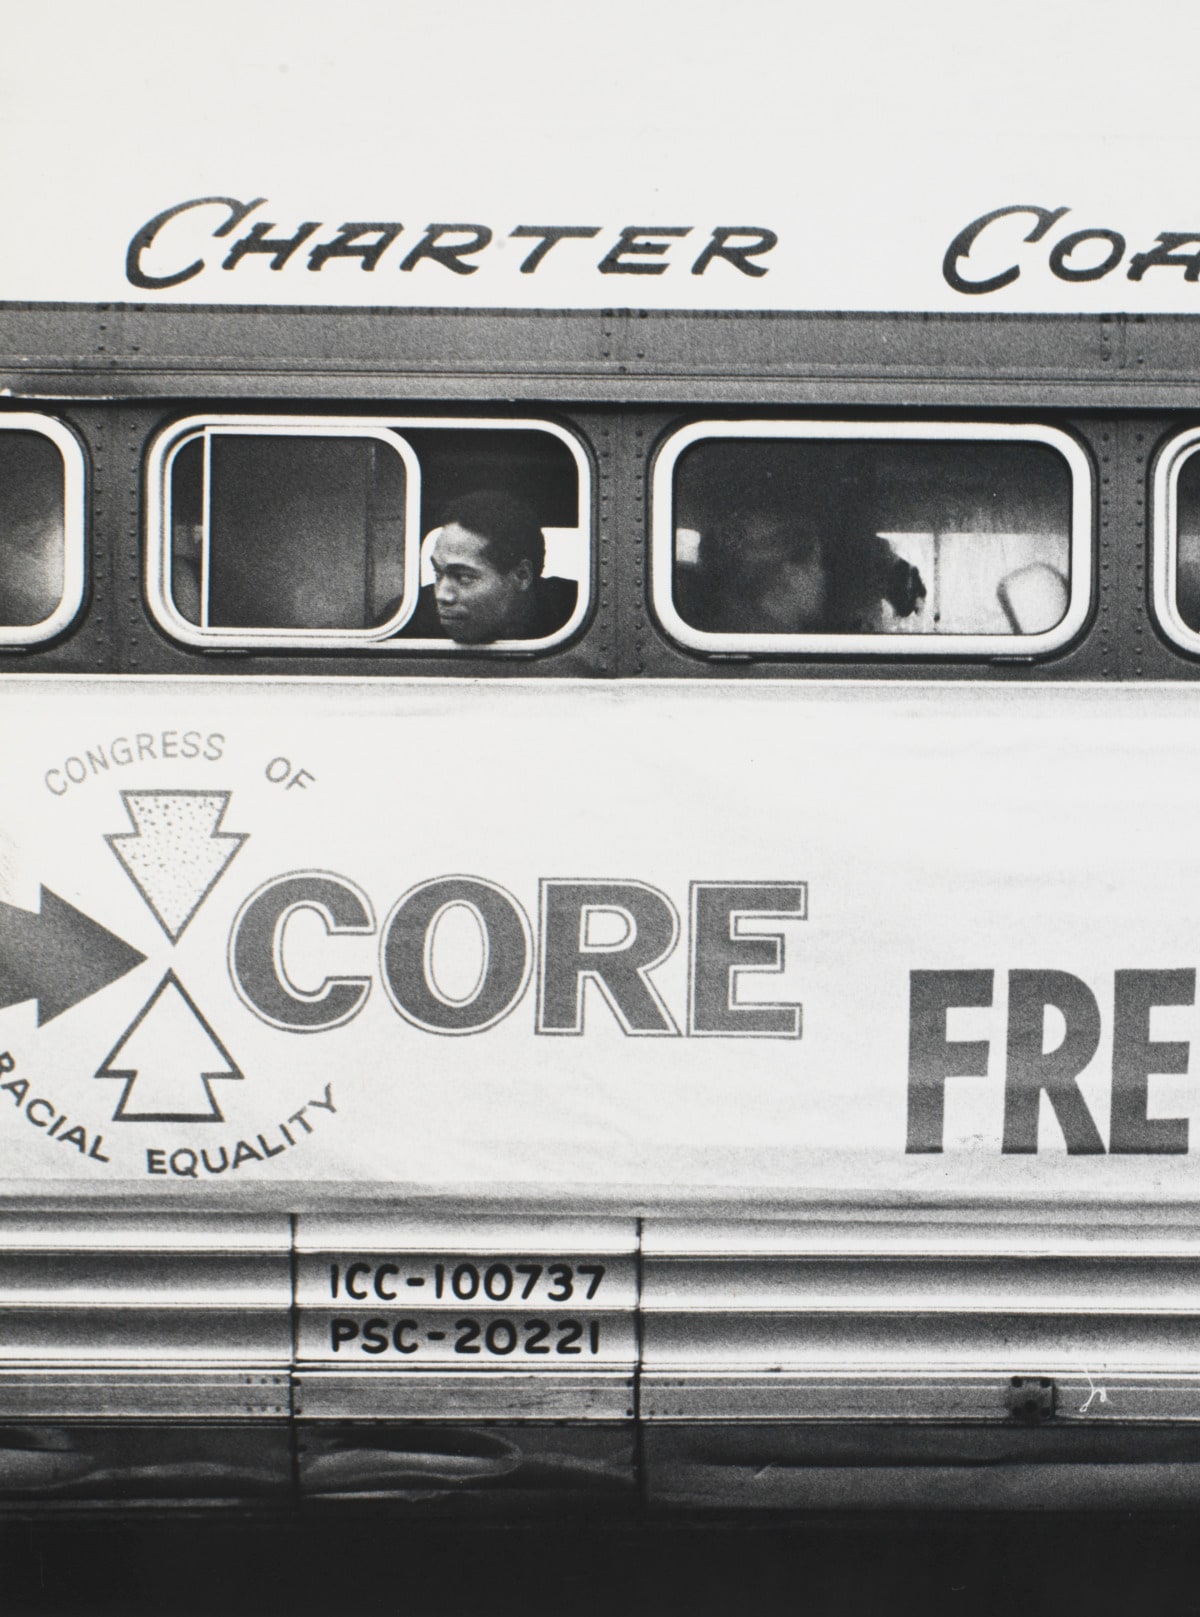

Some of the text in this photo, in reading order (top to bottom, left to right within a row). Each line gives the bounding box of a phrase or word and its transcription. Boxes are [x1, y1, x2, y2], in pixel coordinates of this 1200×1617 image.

[125, 196, 778, 289] CHARTER
[44, 730, 316, 797] CONGRESS OF
[226, 868, 809, 1040] CORE
[146, 1082, 338, 1178] EQUALITY
[330, 1262, 606, 1301] ICC-100737
[330, 1317, 600, 1355] PSC-20221
